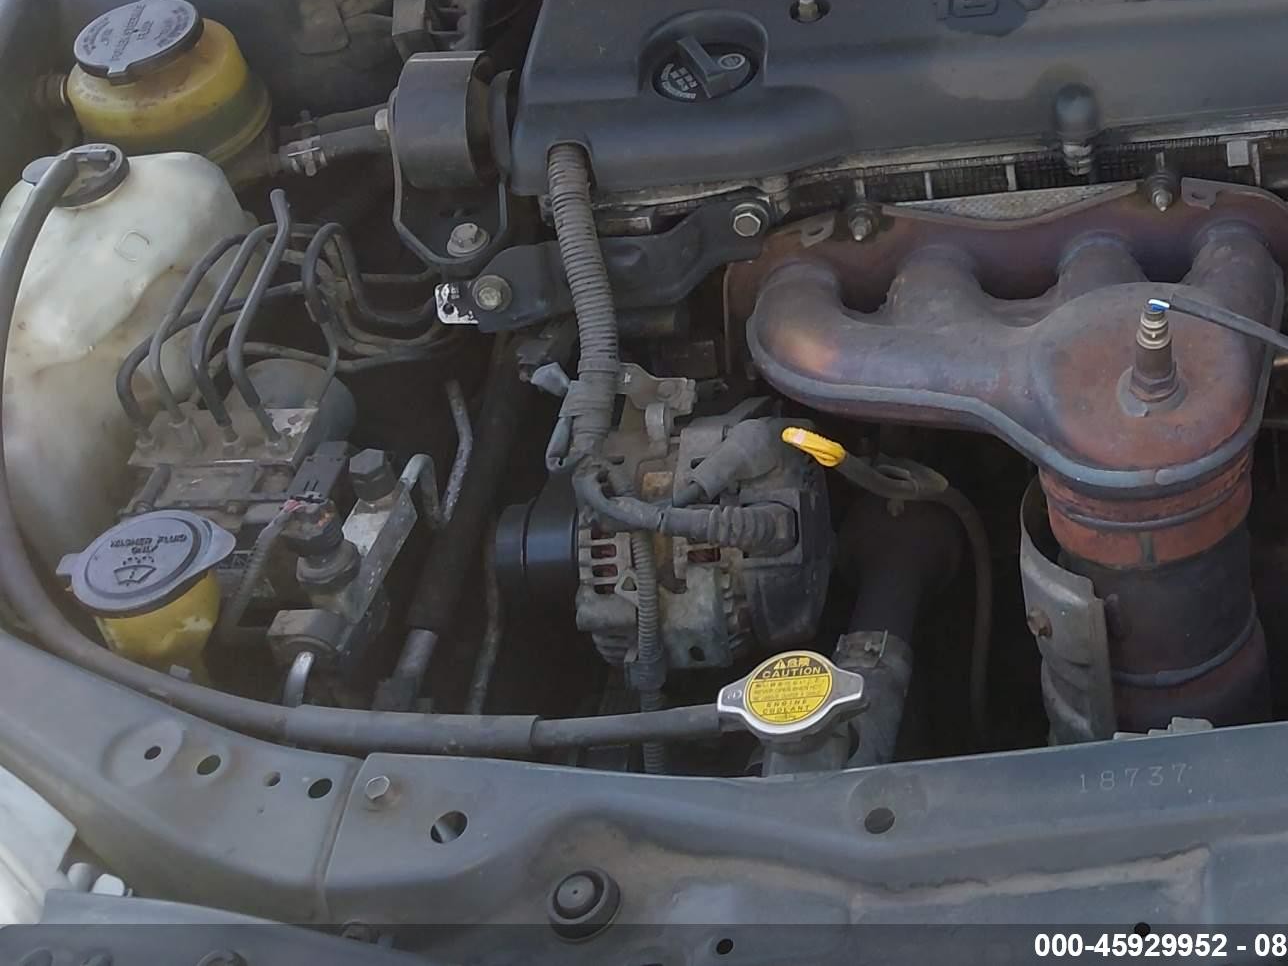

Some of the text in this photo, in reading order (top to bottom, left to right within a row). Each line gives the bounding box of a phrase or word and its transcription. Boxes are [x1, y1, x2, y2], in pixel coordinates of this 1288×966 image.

[762, 666, 822, 679] CAUTION
[766, 699, 808, 708] ENGINE
[762, 705, 811, 715] COOLANT
[1080, 762, 1188, 793] 18737
